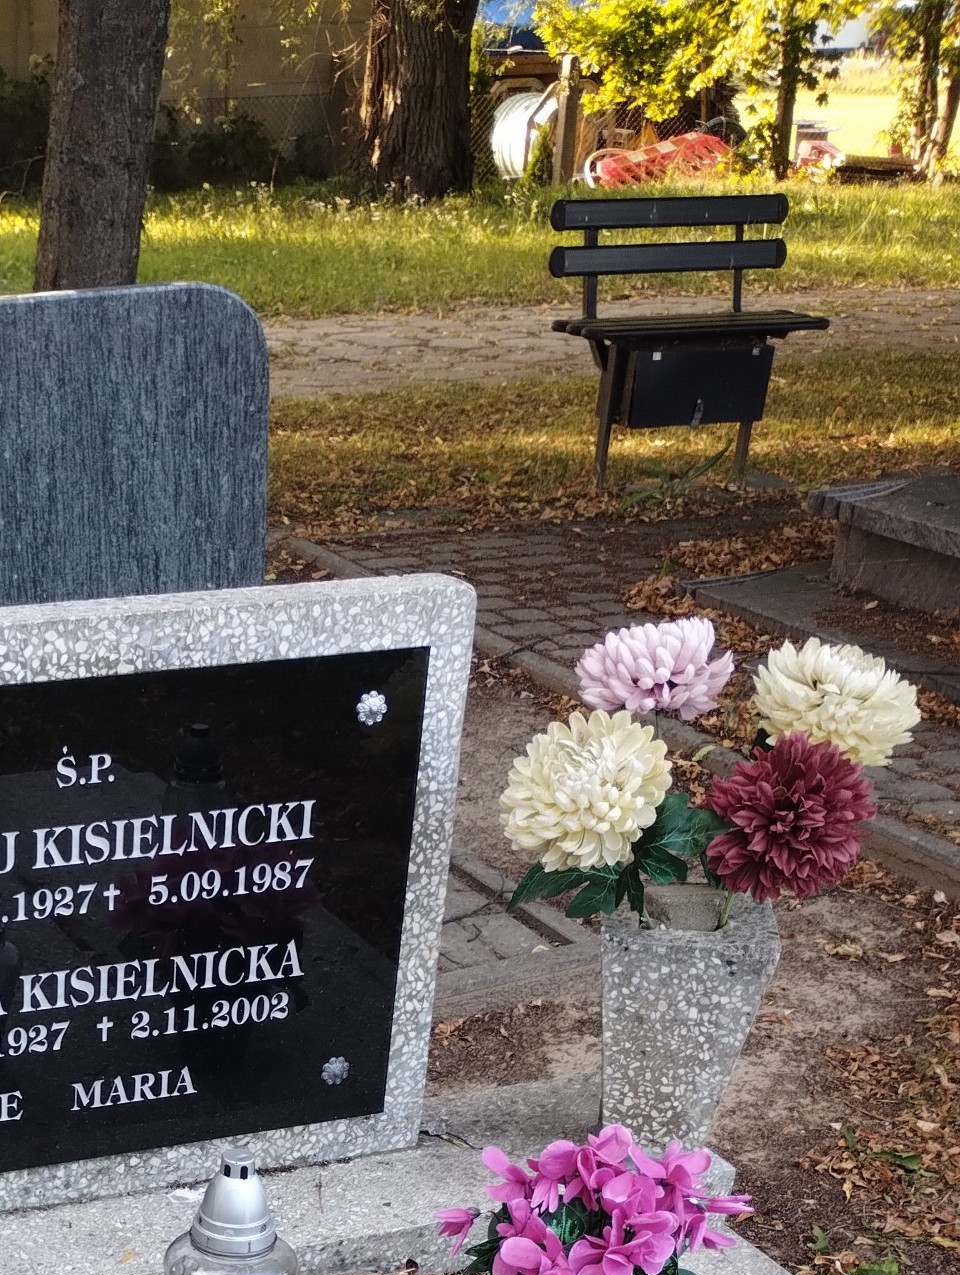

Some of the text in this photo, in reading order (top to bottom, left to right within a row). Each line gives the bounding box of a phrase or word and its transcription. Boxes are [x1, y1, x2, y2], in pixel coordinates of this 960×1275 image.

[32, 800, 316, 870] KISIELNICKI
[147, 858, 314, 906] 5.09.1987
[19, 939, 304, 1014] KISIELNICKA
[130, 992, 291, 1040] 2.11.2002
[70, 1066, 198, 1112] MARIA
